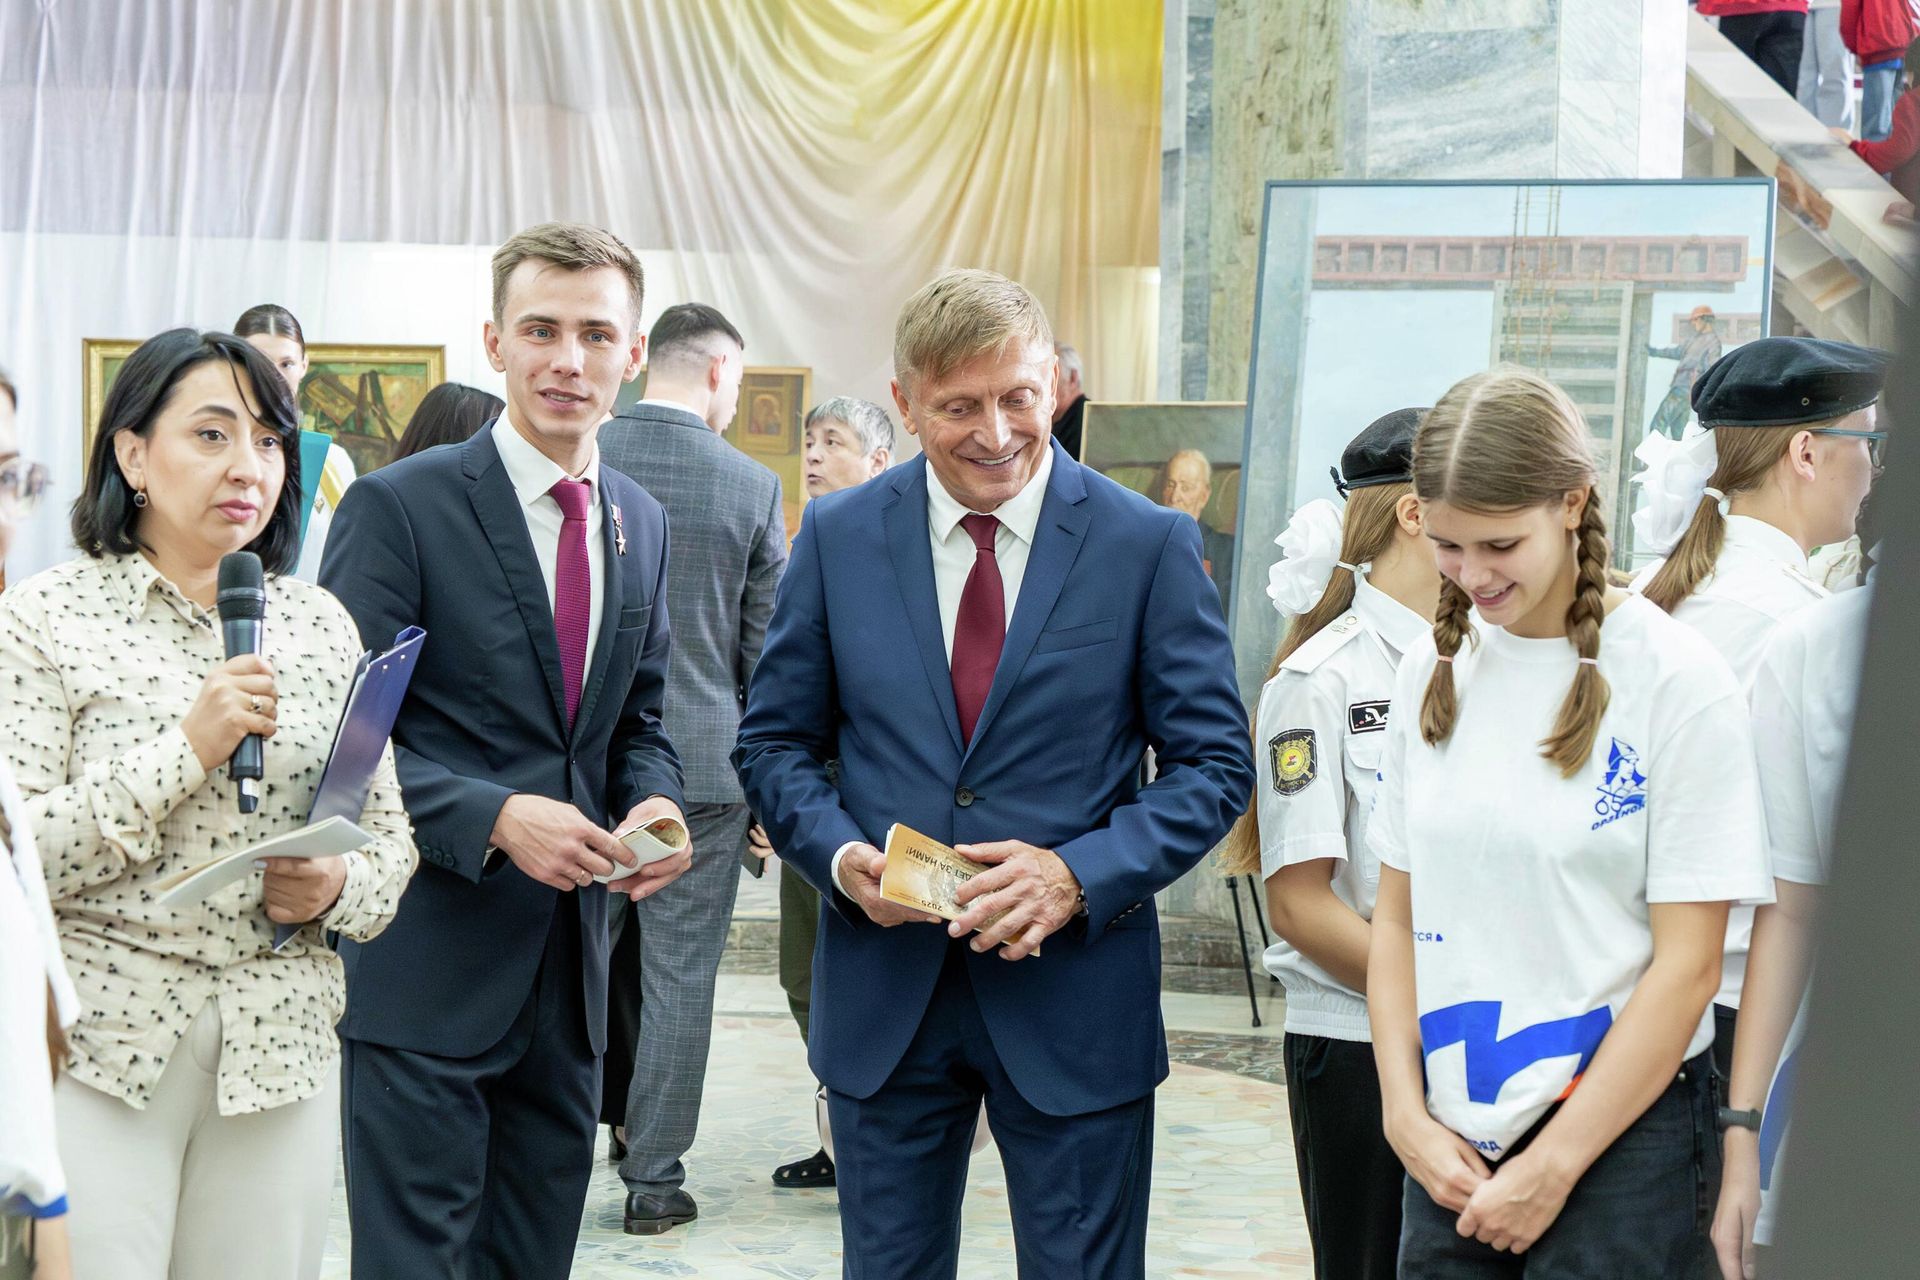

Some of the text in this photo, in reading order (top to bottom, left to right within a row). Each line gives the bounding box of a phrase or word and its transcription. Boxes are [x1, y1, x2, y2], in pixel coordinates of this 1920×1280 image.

[905, 845, 938, 867] НАМИ!
[939, 862, 952, 873] ЗА
[954, 869, 973, 881] ДЕТ
[921, 900, 943, 912] 2025
